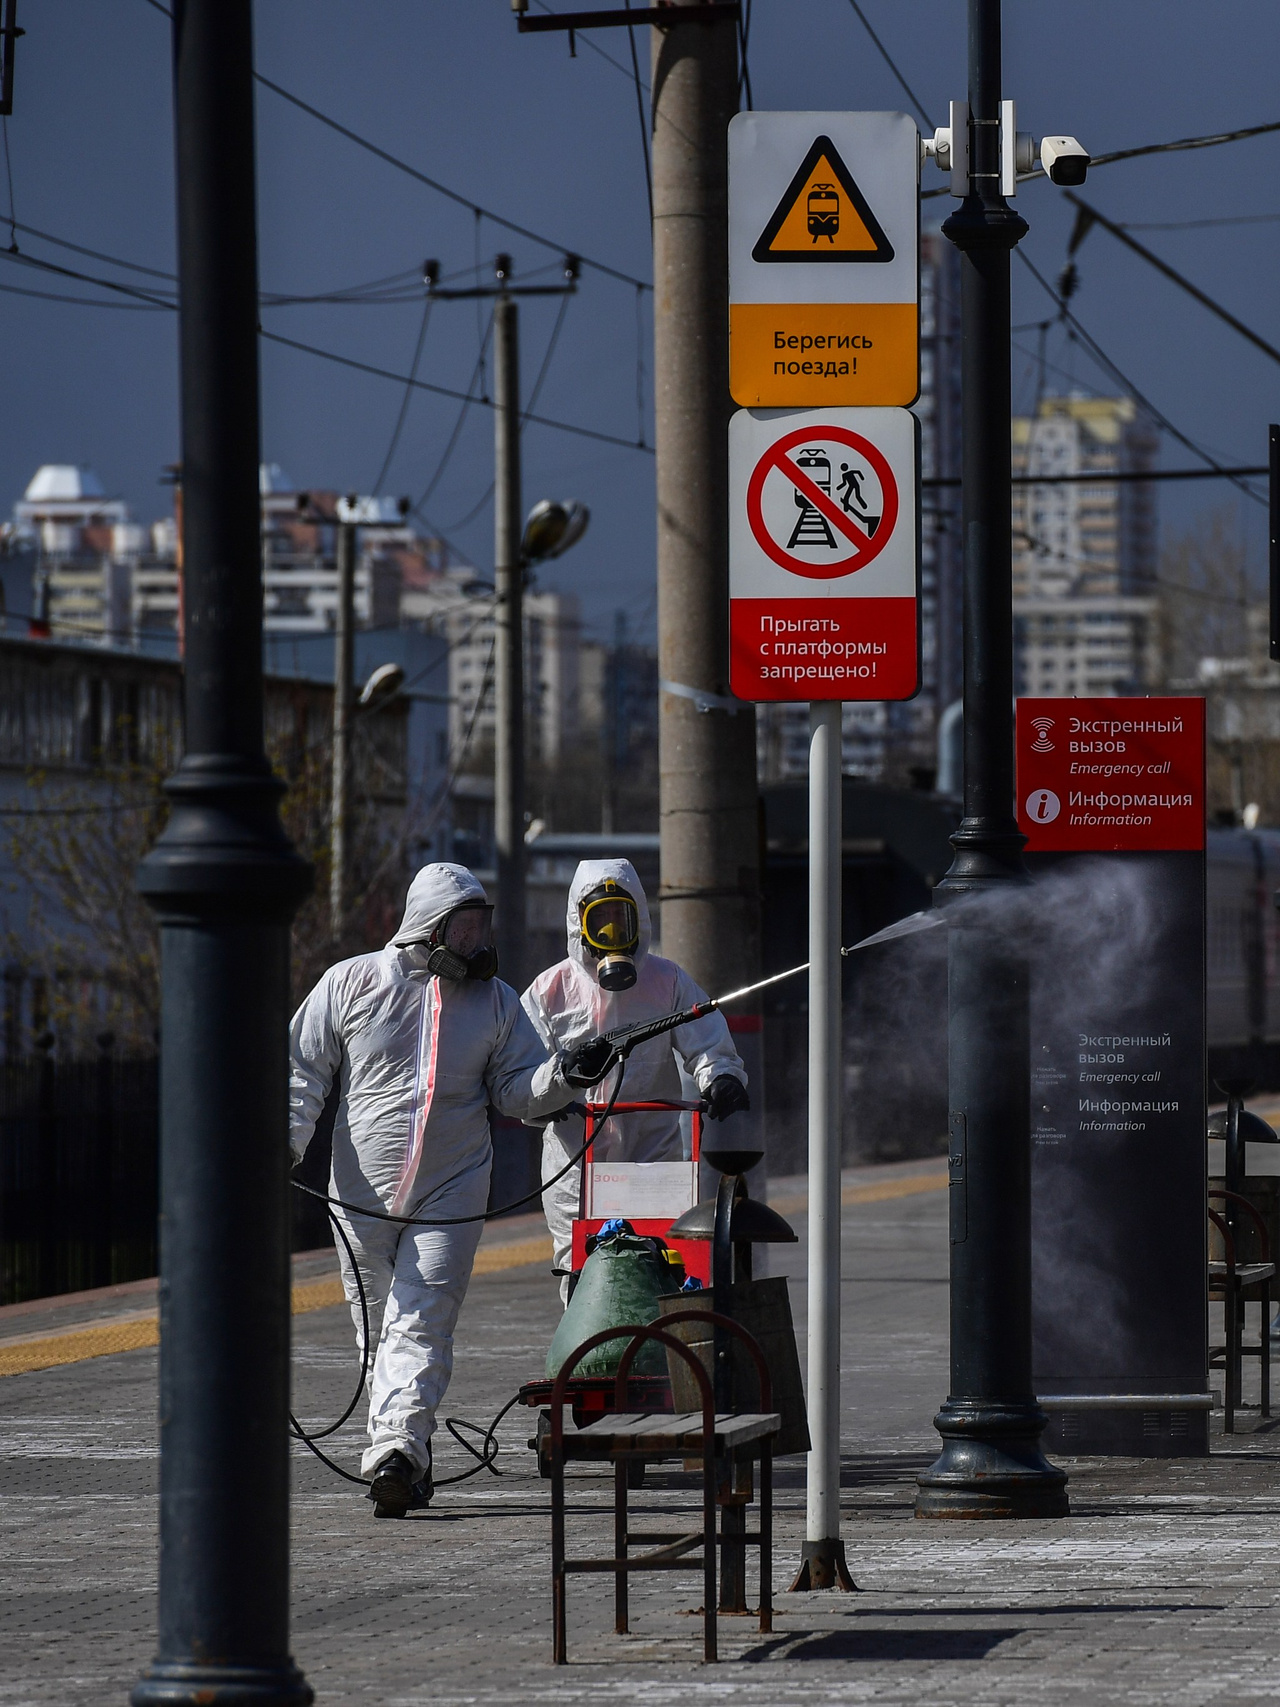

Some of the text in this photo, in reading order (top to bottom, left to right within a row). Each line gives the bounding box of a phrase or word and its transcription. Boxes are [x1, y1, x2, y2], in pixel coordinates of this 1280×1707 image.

[773, 331, 873, 353] Берегись
[773, 357, 858, 378] поезда!
[760, 615, 841, 636] Прыгать
[760, 639, 887, 659] с платформы
[760, 661, 877, 682] запрещено!
[1068, 716, 1184, 737] Экстренный
[1069, 740, 1127, 753] вызов
[1069, 761, 1171, 777] Emergency call
[1068, 790, 1193, 810] Информация
[1069, 813, 1152, 825] Information
[1078, 1033, 1171, 1049] Экстренный
[1079, 1053, 1125, 1064] вызов
[1079, 1071, 1161, 1084] Emergency call
[1078, 1098, 1179, 1115] Информация
[1079, 1120, 1146, 1131] Information
